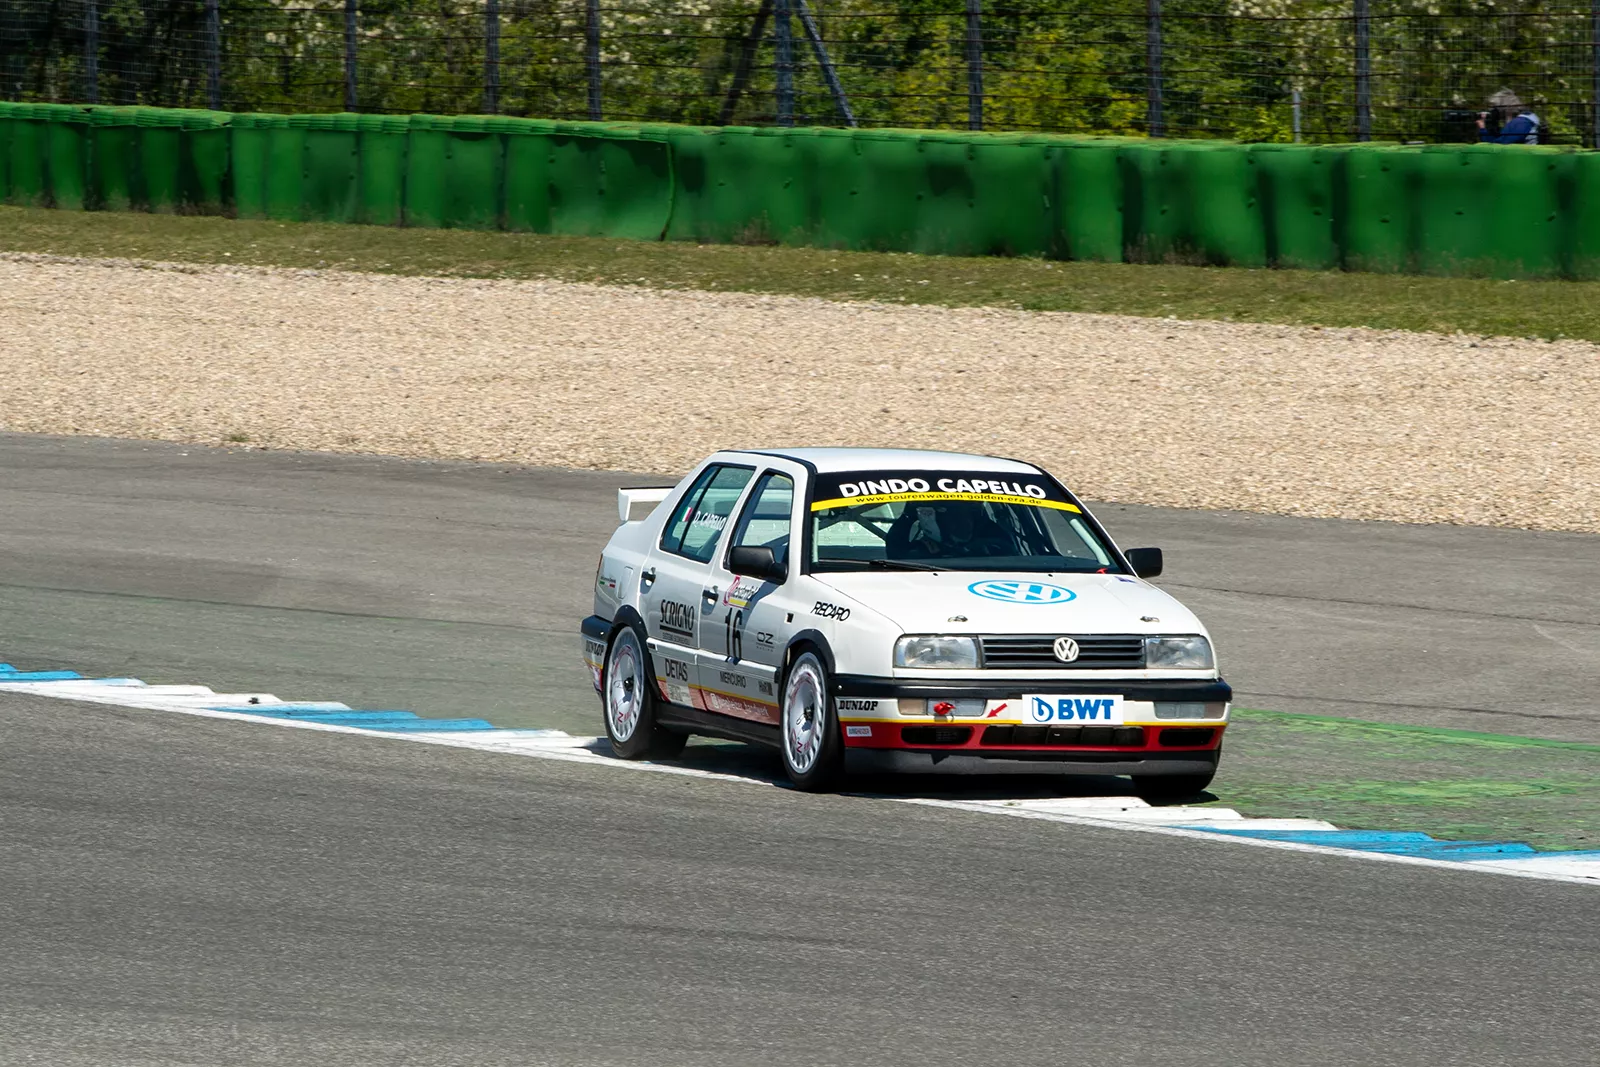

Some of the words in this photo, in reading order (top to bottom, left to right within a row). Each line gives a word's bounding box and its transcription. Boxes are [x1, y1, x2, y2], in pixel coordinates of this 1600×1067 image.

[839, 478, 930, 498] DINDO
[937, 478, 1046, 499] CAPELLO
[855, 491, 1042, 505] www.tourenwagen-golden-era.de
[660, 599, 695, 631] SCRIGNO
[811, 601, 850, 621] RECARO
[725, 607, 743, 661] 16
[757, 631, 774, 645] OZ
[665, 658, 689, 682] DETAS
[720, 671, 747, 688] MERCURIO
[838, 701, 878, 711] DUNLOP
[1058, 699, 1114, 720] BWT
